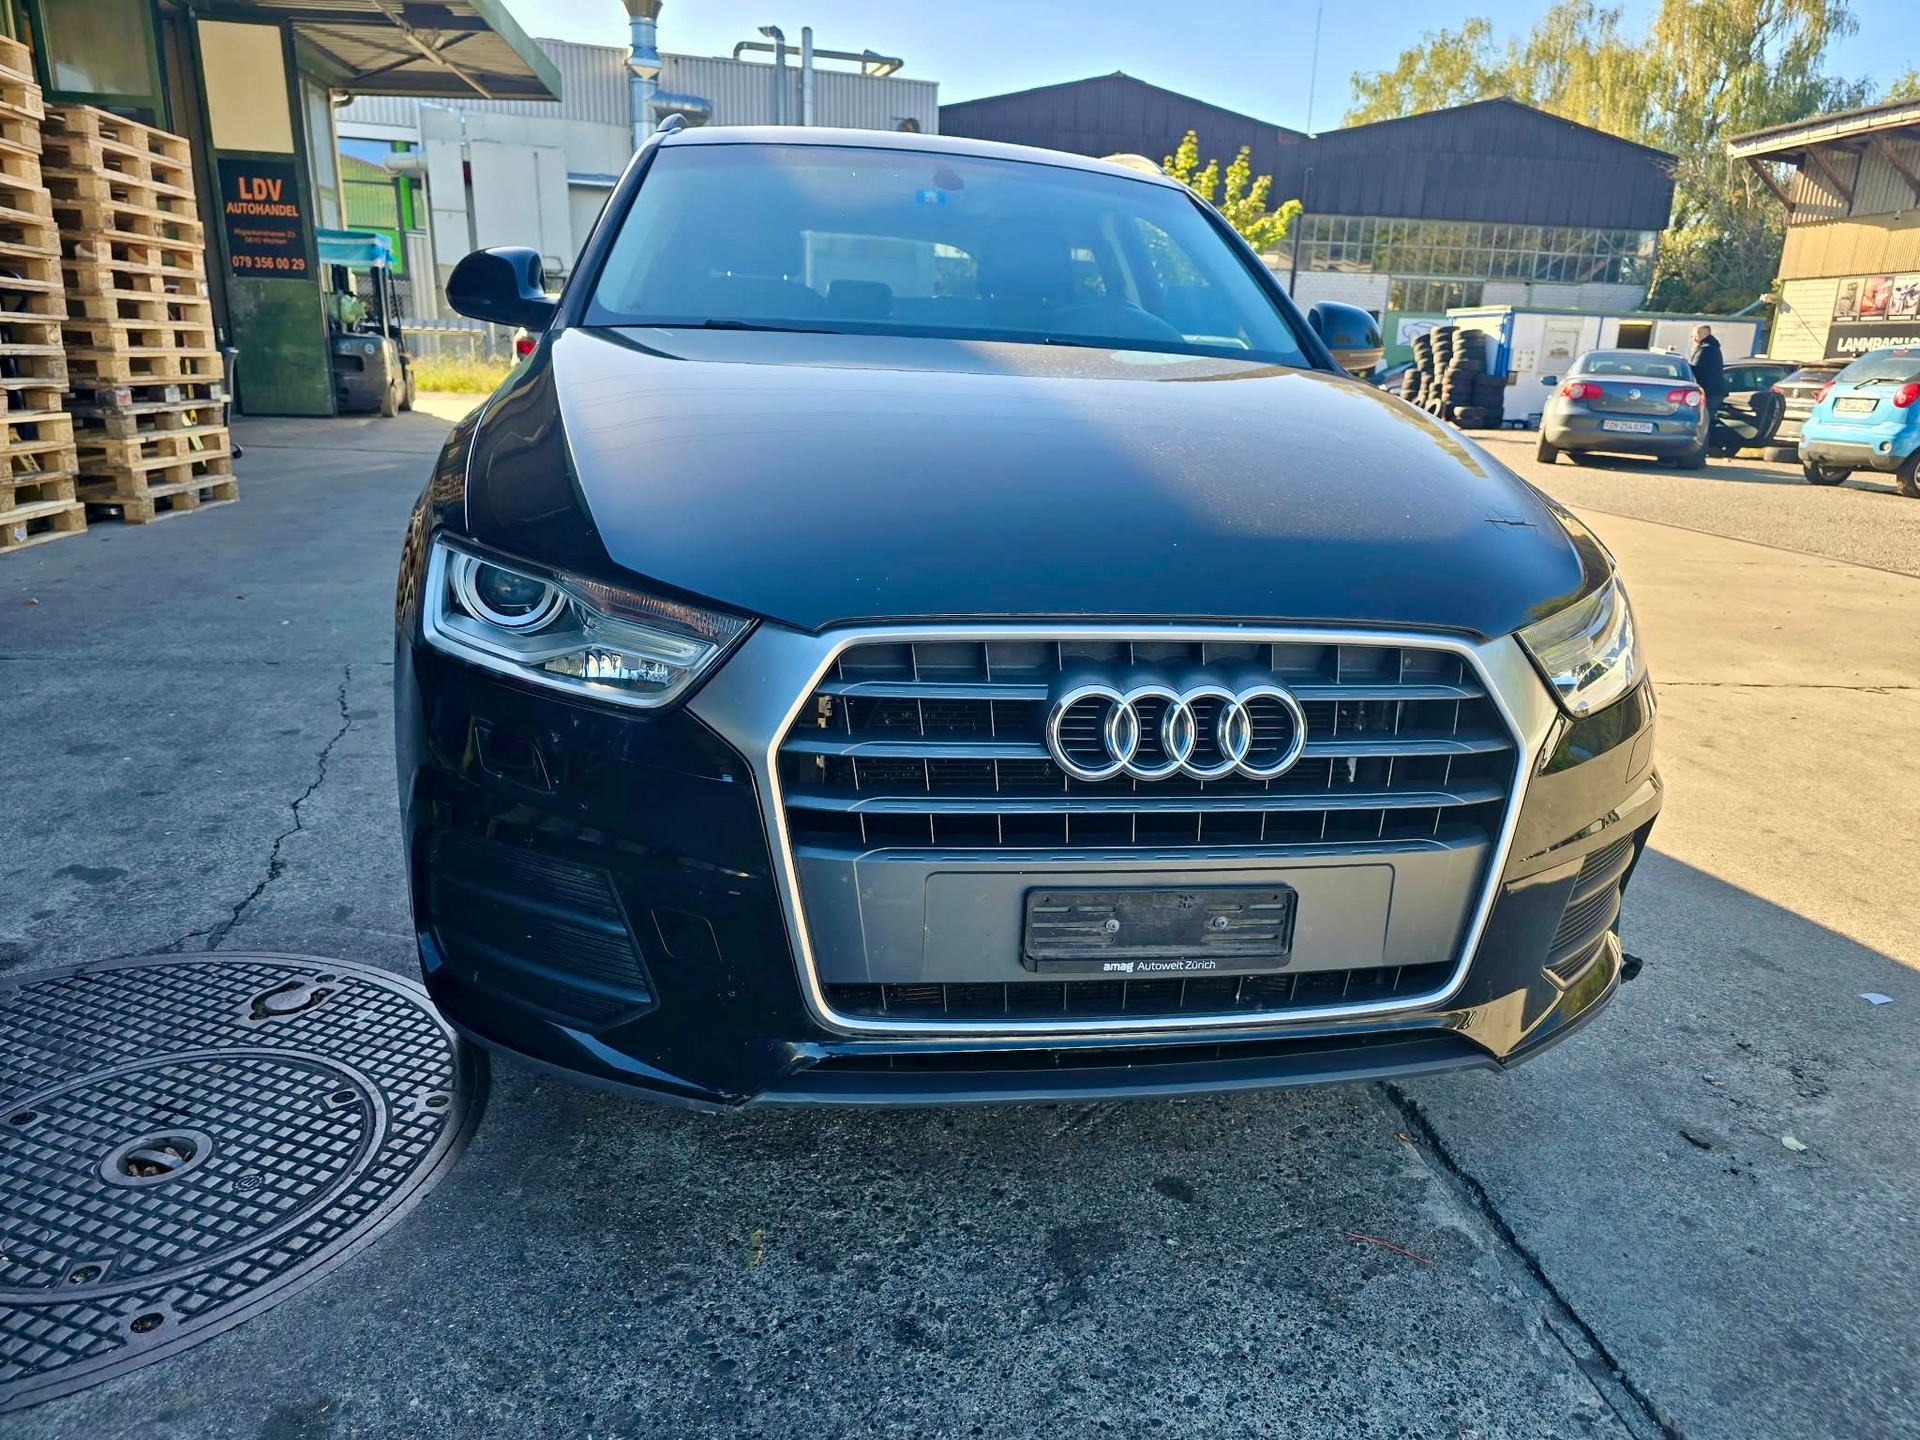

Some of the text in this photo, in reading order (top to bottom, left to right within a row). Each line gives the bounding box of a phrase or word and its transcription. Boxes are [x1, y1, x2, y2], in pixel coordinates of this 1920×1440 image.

[239, 177, 282, 201] LDV
[227, 202, 299, 216] AUTOHANDEL
[232, 256, 305, 270] 079 356 00 29
[1103, 961, 1134, 972] amag
[1137, 960, 1183, 971] Autowelt
